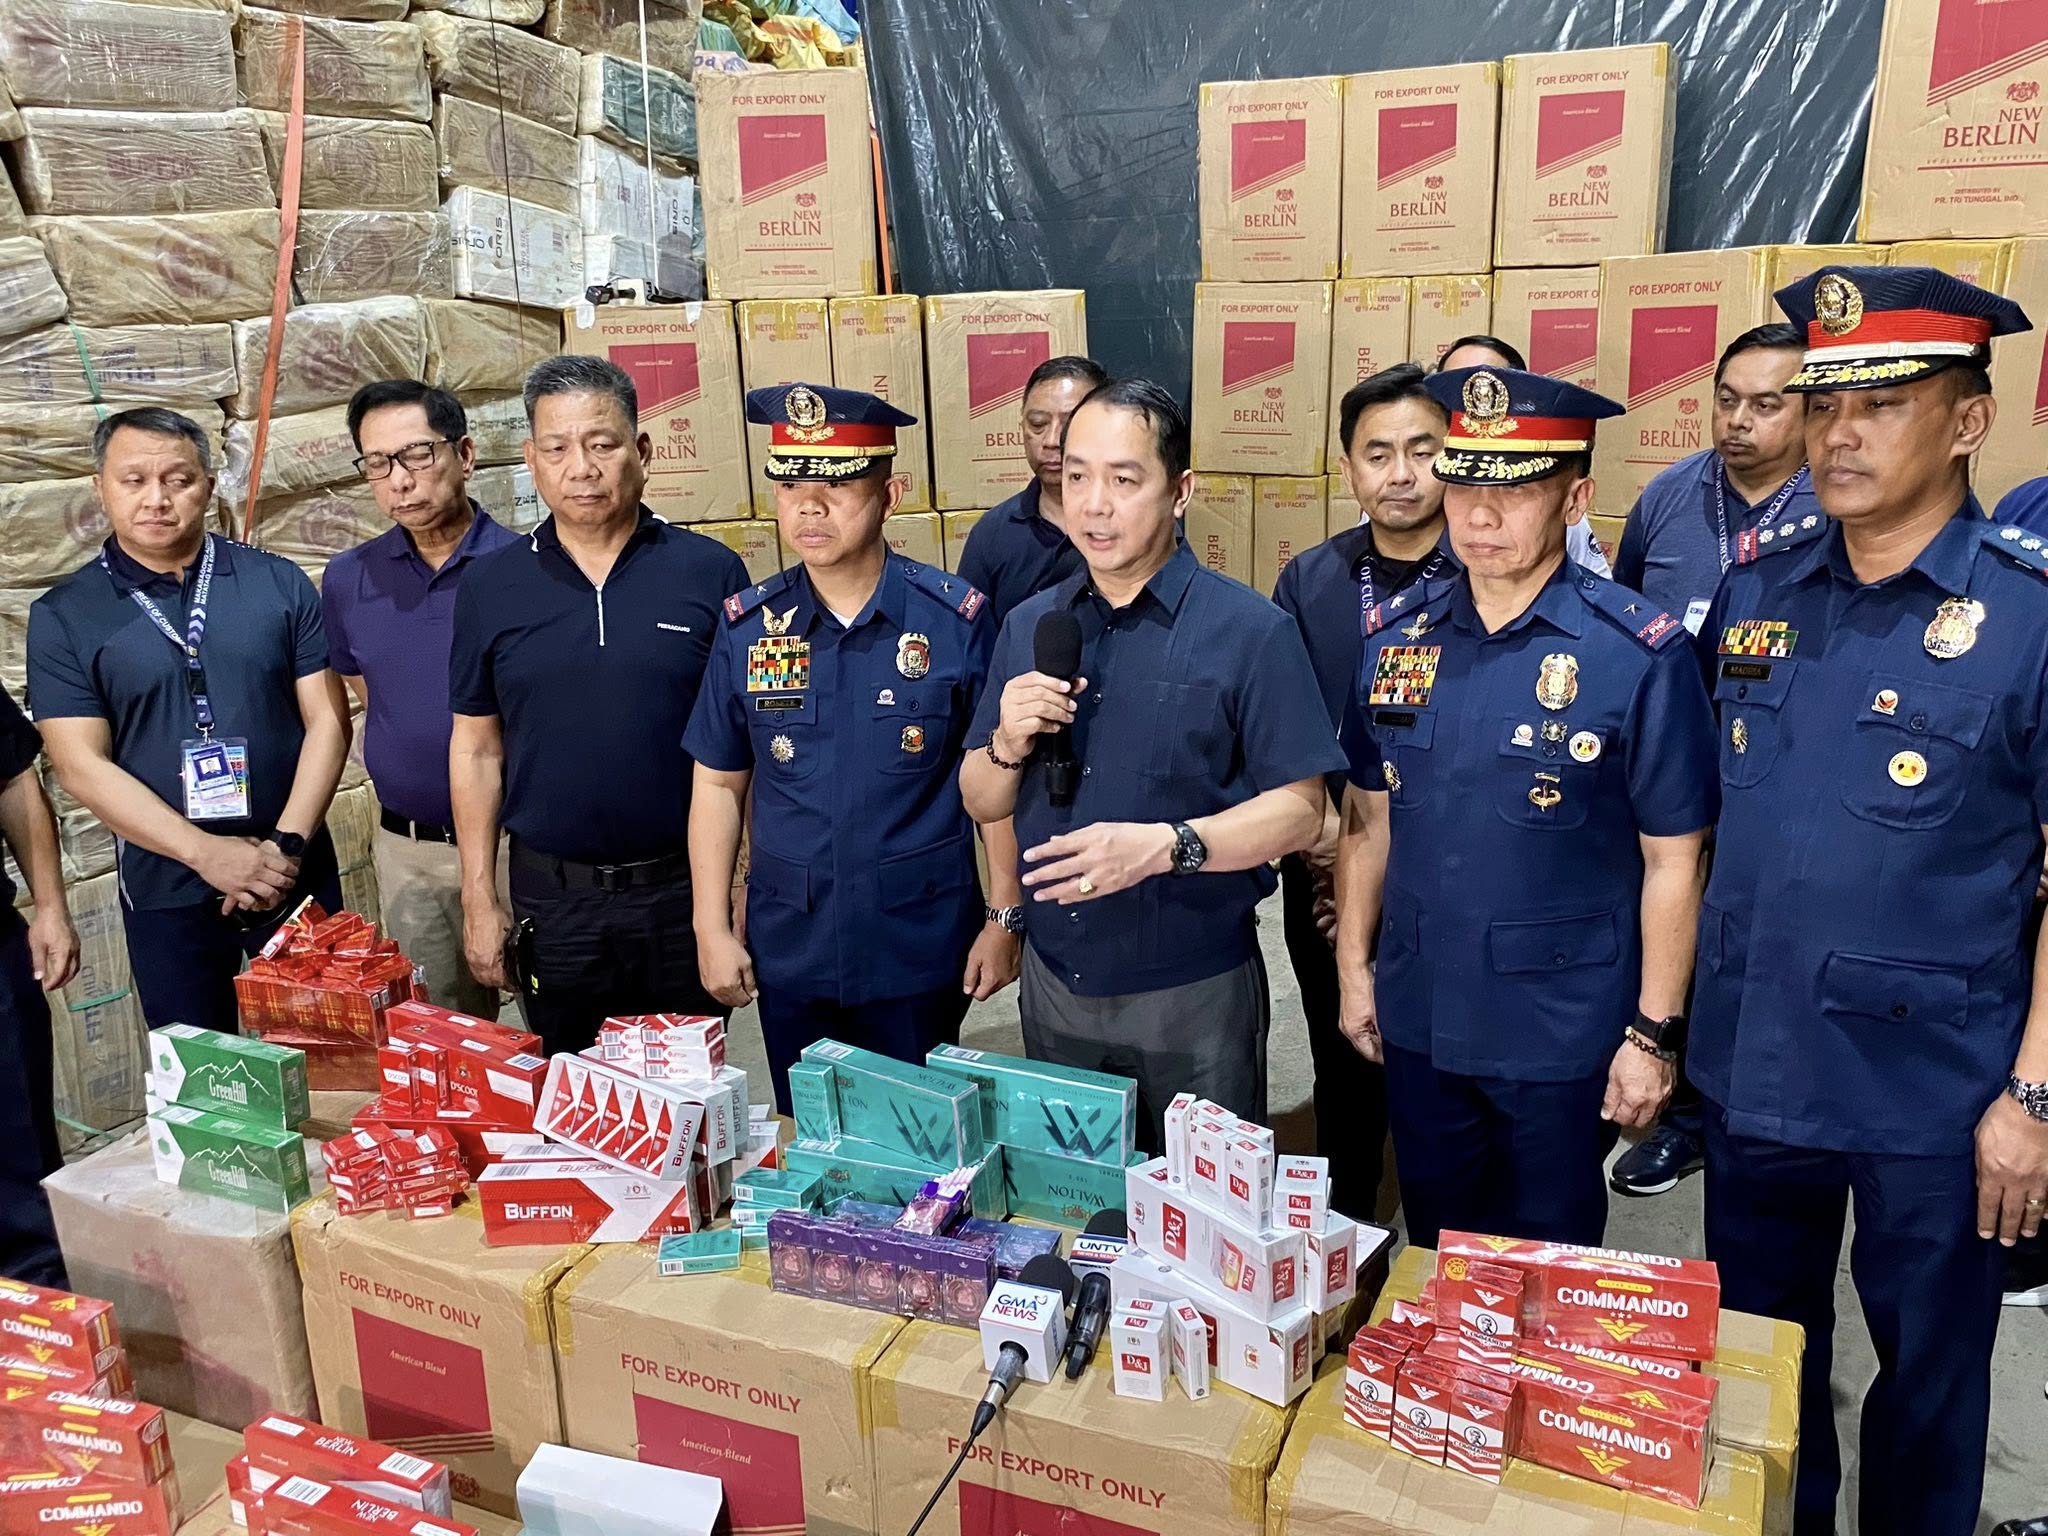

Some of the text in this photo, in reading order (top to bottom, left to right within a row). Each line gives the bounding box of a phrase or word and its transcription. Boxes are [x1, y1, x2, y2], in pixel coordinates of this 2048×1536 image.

[1536, 71, 1629, 86] FOR EXPORT ONLY
[732, 94, 826, 105] FOR EXPORT ONLY
[1375, 84, 1460, 99] FOR EXPORT ONLY
[1228, 101, 1309, 114] FOR EXPORT ONLY
[1999, 107, 2043, 122] NEW
[1943, 122, 2040, 148] BERLIN
[1583, 181, 1610, 192] NEW
[1422, 191, 1447, 201] NEW
[1549, 191, 1609, 207] BERLIN
[793, 210, 821, 220] NEW
[1273, 204, 1297, 213] NEW
[1390, 201, 1447, 217] BERLIN
[1244, 213, 1297, 227] BERLIN
[759, 221, 821, 236] BERLIN
[495, 217, 503, 259] ORIS
[1528, 292, 1548, 300] FOR
[1550, 290, 1588, 300] EXPORT
[1629, 281, 1722, 296] FOR EXPORT ONLY
[1221, 305, 1299, 313] FOR EXPORT ONLY
[962, 313, 1050, 323] FOR EXPORT ONLY
[602, 323, 697, 334] FOR EXPORT ONLY
[1356, 347, 1370, 384] BERL
[1262, 402, 1285, 410] NEW
[1233, 410, 1284, 423] BERLIN
[1674, 419, 1703, 430] NEW
[668, 434, 696, 444] NEW
[985, 432, 1024, 447] BERL
[1640, 431, 1700, 448] BERLIN
[1207, 534, 1219, 572] BERL
[1360, 566, 1371, 582] OF
[200, 574, 212, 605] MATATAG
[964, 595, 977, 611] PNP
[151, 607, 163, 617] OF
[1648, 620, 1667, 636] PNP
[208, 1074, 248, 1105] GreenHill
[580, 1100, 596, 1112] BUFFON
[732, 1089, 741, 1133] BUFFON
[605, 1109, 621, 1121] BUFFON
[630, 1119, 646, 1131] BUFFON
[716, 1105, 727, 1150] BUFFON
[672, 1119, 692, 1167] BUFFON
[207, 1159, 249, 1190] GreenHill
[558, 1164, 615, 1173] BUFFON
[1198, 1159, 1214, 1179] D&J
[1291, 1169, 1314, 1178] D&J
[1048, 1183, 1106, 1208] WALTON
[1232, 1177, 1248, 1198] D&J
[1290, 1196, 1308, 1208] D&J
[503, 1203, 573, 1220] BUFFON
[1290, 1216, 1307, 1227] D&J
[1166, 1211, 1184, 1249] D&J
[1080, 1241, 1124, 1253] UNTV
[1545, 1242, 1683, 1268] COMMANDO
[1329, 1252, 1345, 1285] D&J
[1243, 1269, 1254, 1286] D&J
[1275, 1261, 1292, 1296] D&J
[339, 1271, 482, 1330] FOR EXPORT ONLY
[997, 1294, 1038, 1311] GMA
[1136, 1300, 1151, 1310] D&J
[1556, 1287, 1689, 1319] COMMANDO
[992, 1305, 1039, 1321] NEWS
[1131, 1317, 1145, 1327] D&J
[2, 1318, 74, 1348] COMMANDO
[1465, 1329, 1508, 1348] COMMANDO
[389, 1350, 447, 1376] American Blend
[1126, 1355, 1148, 1371] D&J
[1544, 1339, 1682, 1380] COMMANDO
[621, 1353, 801, 1414] FOR EXPORT ONLY
[47, 1390, 136, 1415] COMMANDO
[1350, 1394, 1388, 1416] COMMANDO
[1398, 1420, 1441, 1442] COMMANDO
[1538, 1408, 1672, 1460] COMMANDO
[42, 1427, 123, 1455] COMMANDO
[314, 1436, 359, 1457] BERLIN
[334, 1436, 355, 1446] NEW
[679, 1437, 752, 1465] American Blend
[1453, 1439, 1497, 1461] COMMANDO
[947, 1436, 1166, 1509] FOR EXPORT ONLY
[39, 1500, 144, 1522] COMMANDO
[351, 1499, 399, 1520] BERLIN
[356, 1510, 380, 1523] NEW
